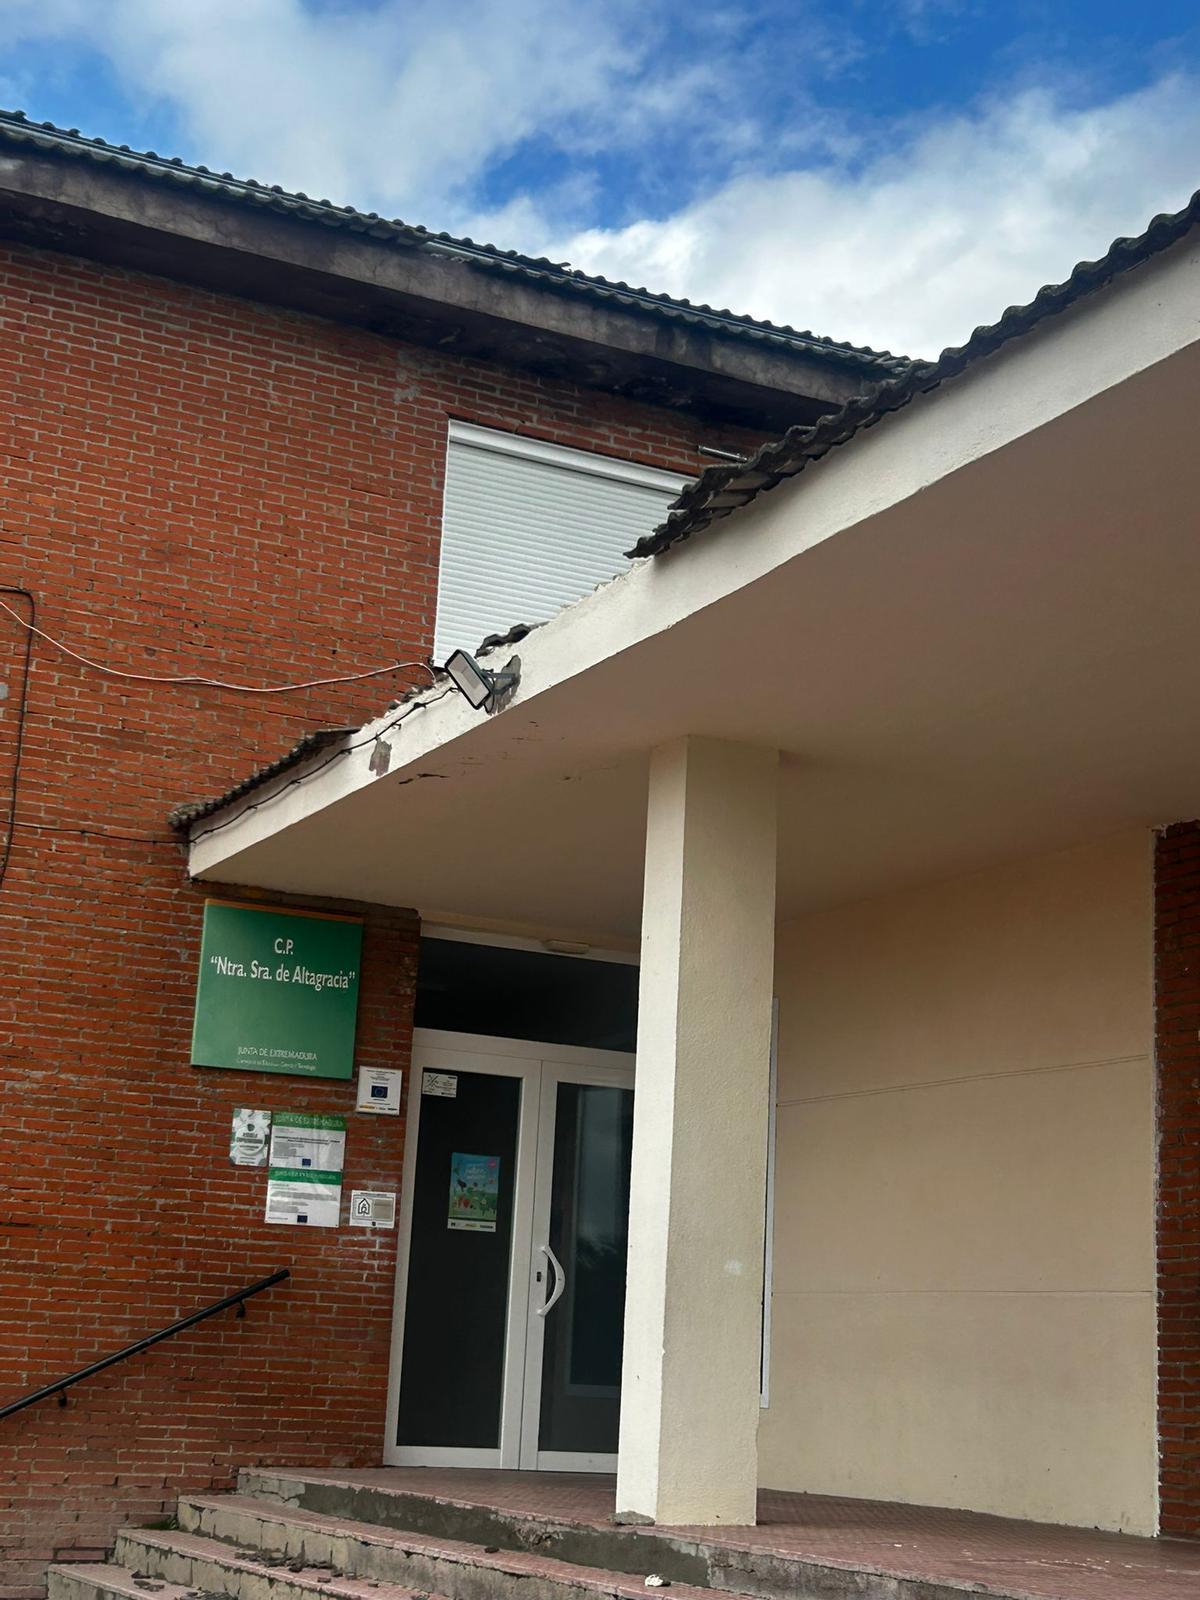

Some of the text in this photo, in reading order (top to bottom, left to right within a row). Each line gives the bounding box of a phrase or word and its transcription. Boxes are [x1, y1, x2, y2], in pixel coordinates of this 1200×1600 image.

[274, 937, 294, 955] C.P.
[250, 960, 272, 980] Sra.
[275, 963, 290, 982] de
[238, 1046, 318, 1061] JUNTA DE EXTREMADURA
